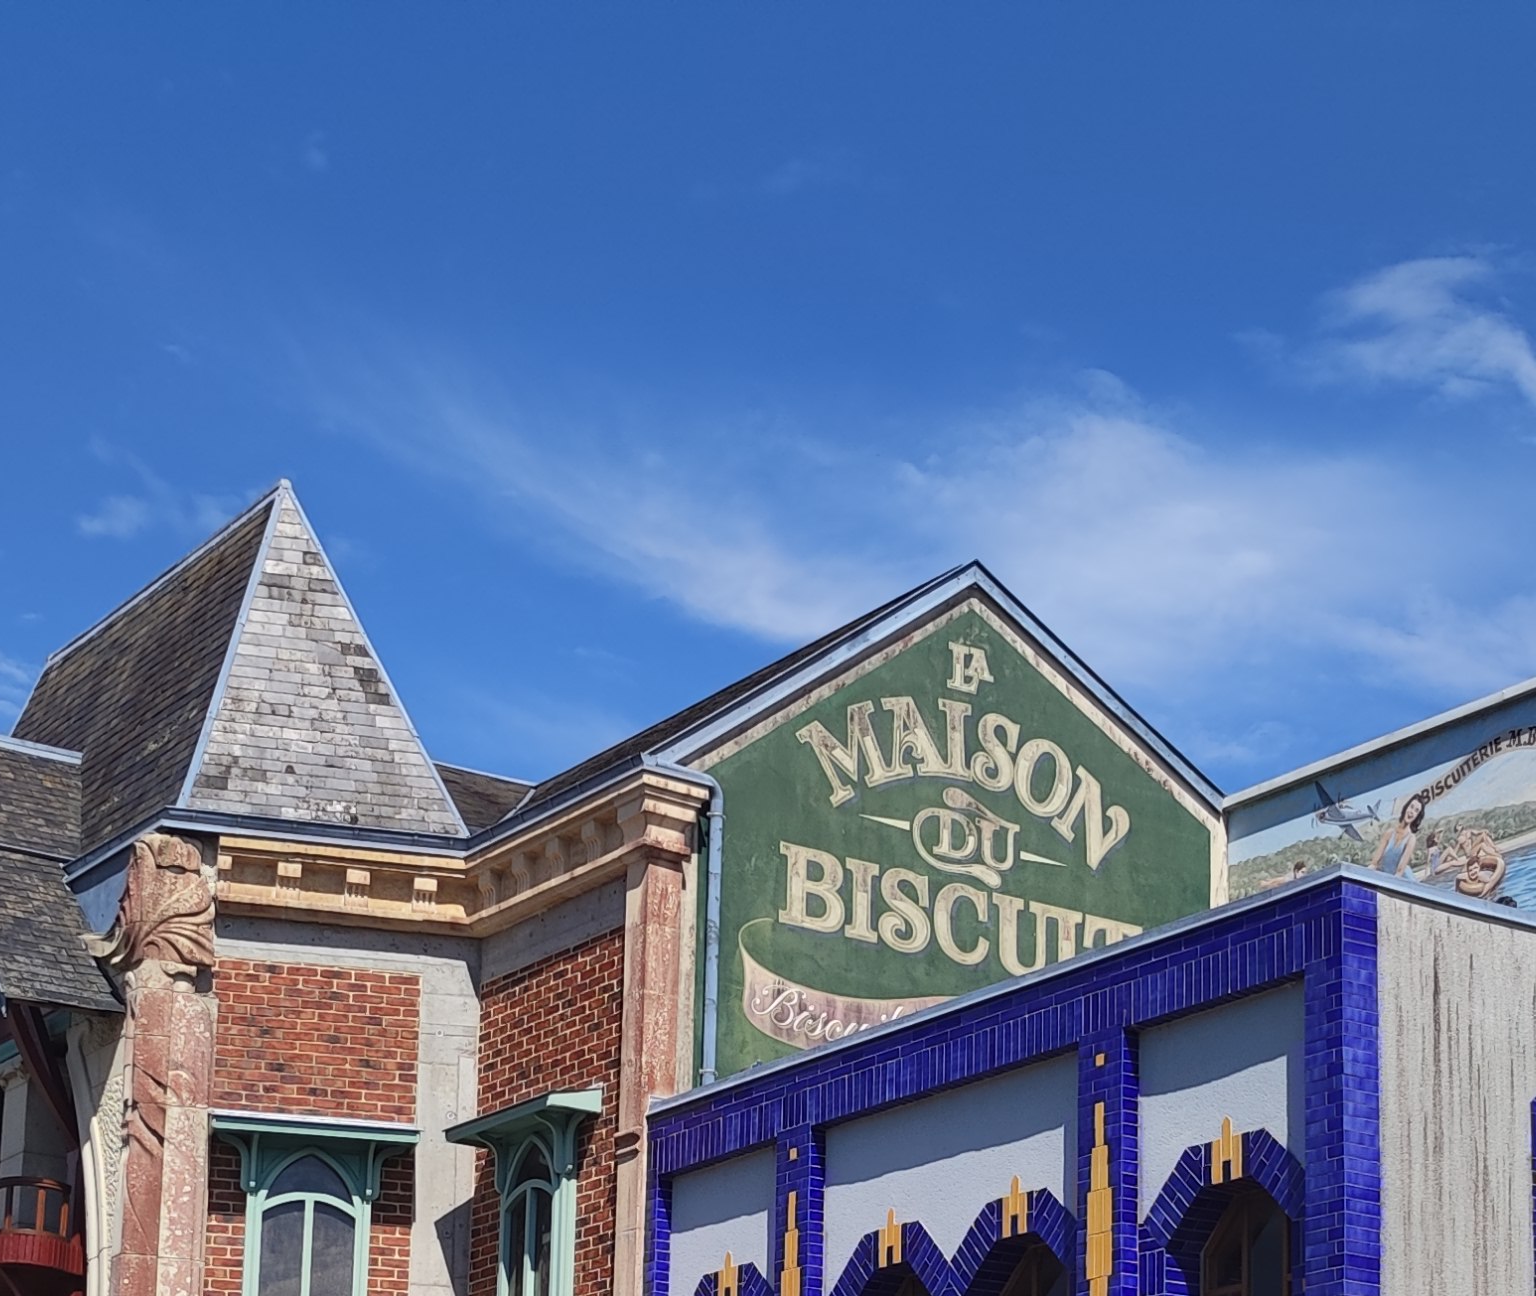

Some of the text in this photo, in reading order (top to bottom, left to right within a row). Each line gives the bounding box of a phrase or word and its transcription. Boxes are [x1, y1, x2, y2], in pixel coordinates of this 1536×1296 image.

[796, 696, 1131, 872] MAISON
[1421, 736, 1503, 805] BISCUITERIE
[916, 800, 1020, 880] DU
